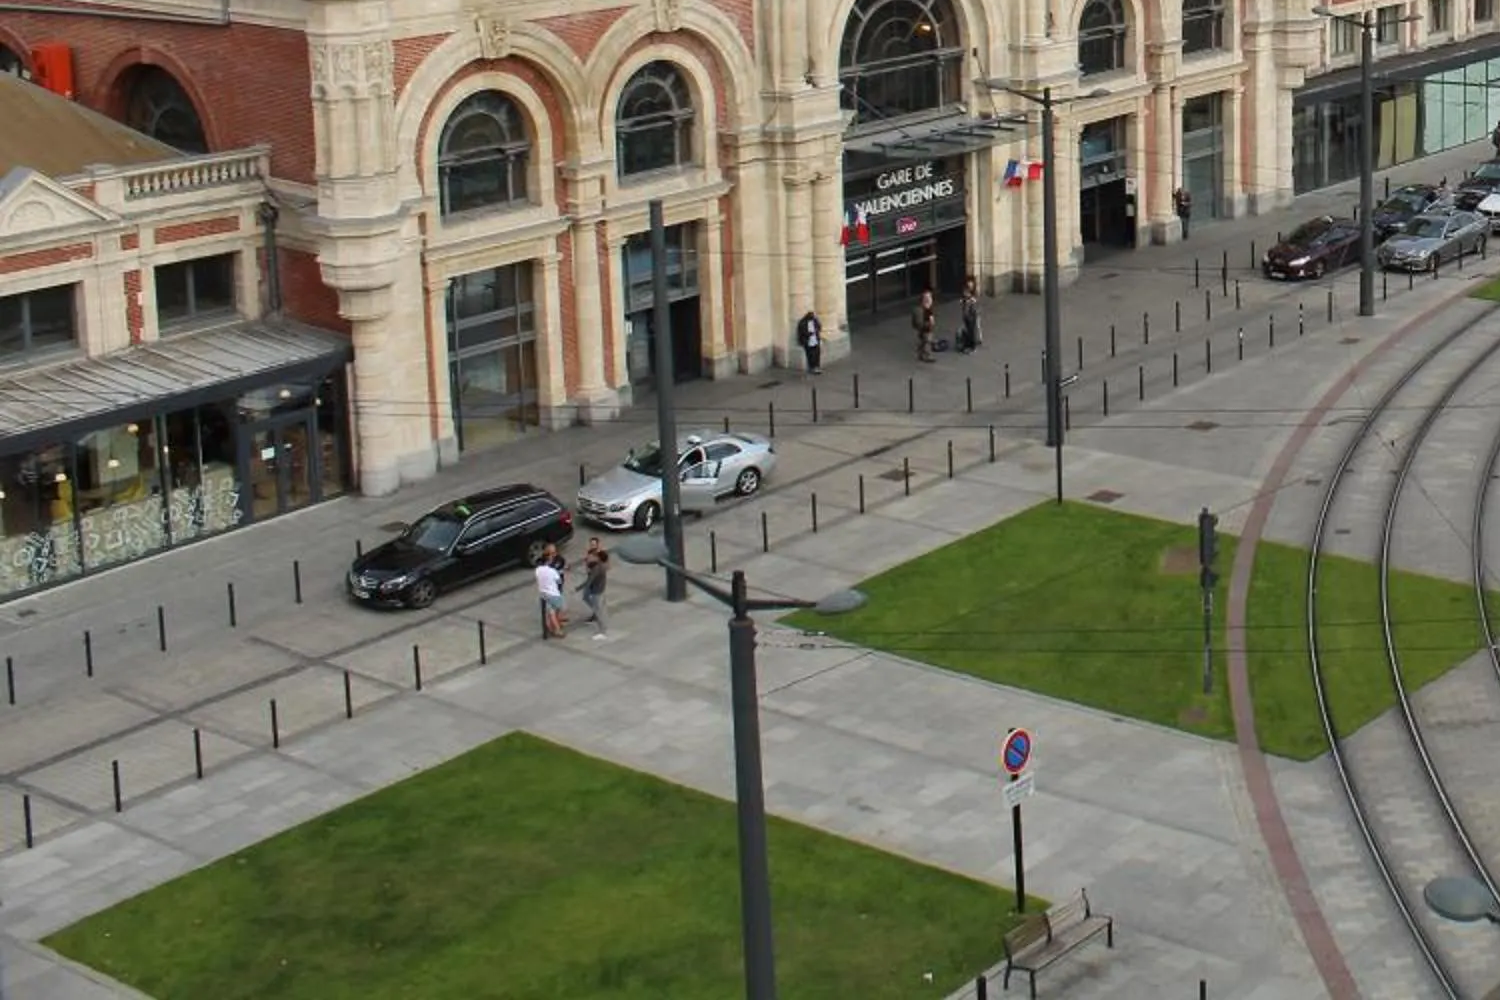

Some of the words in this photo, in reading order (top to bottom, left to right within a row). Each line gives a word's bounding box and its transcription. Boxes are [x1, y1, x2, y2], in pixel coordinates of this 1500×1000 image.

[877, 167, 912, 189] GARE
[915, 161, 933, 180] DE
[855, 179, 953, 215] VALENCIENNES
